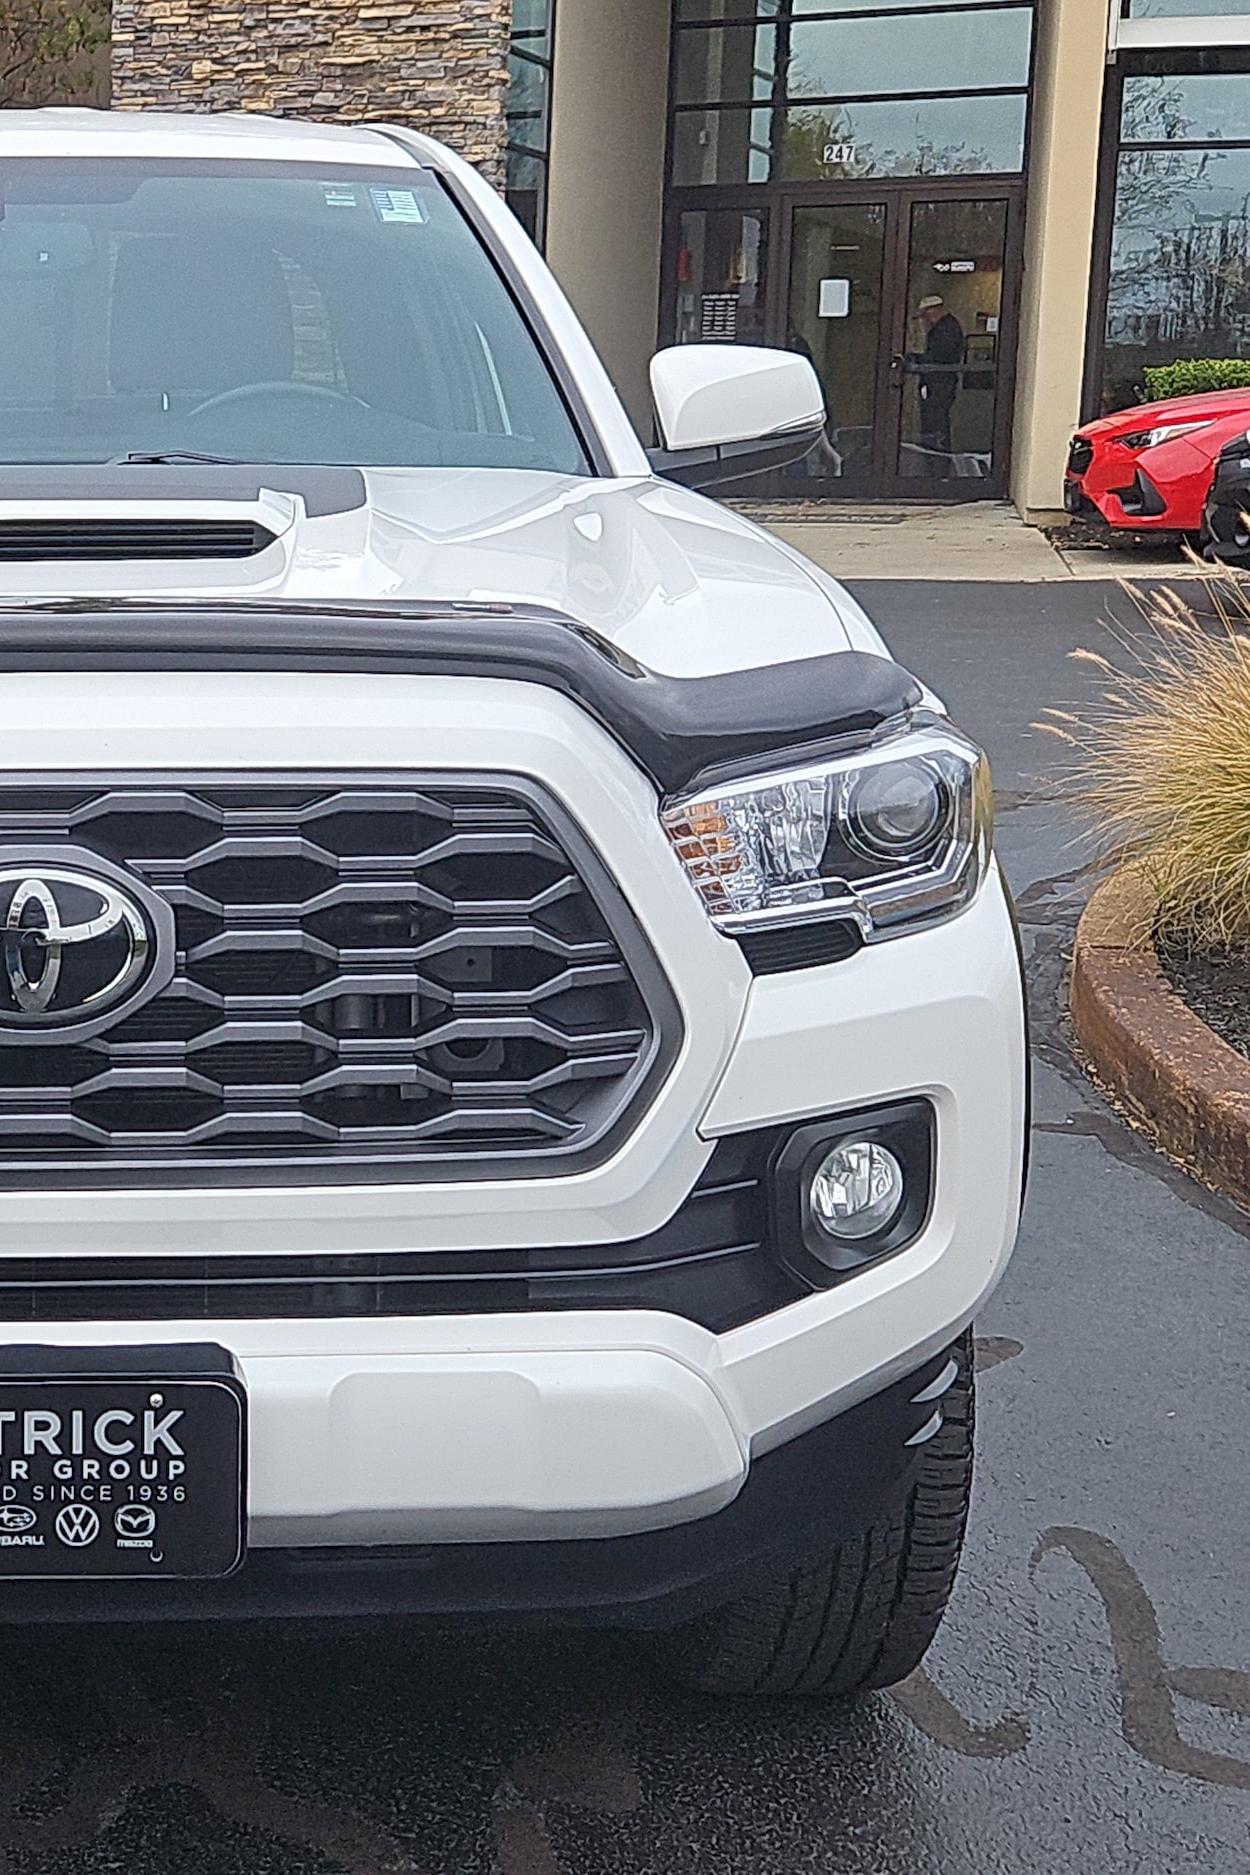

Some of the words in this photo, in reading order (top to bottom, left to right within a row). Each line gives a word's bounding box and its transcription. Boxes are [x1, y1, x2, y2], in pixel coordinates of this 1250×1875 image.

[825, 145, 855, 162] 247
[53, 1459, 186, 1480] GROUP
[33, 1486, 112, 1501] SINCE
[127, 1485, 186, 1501] 1936
